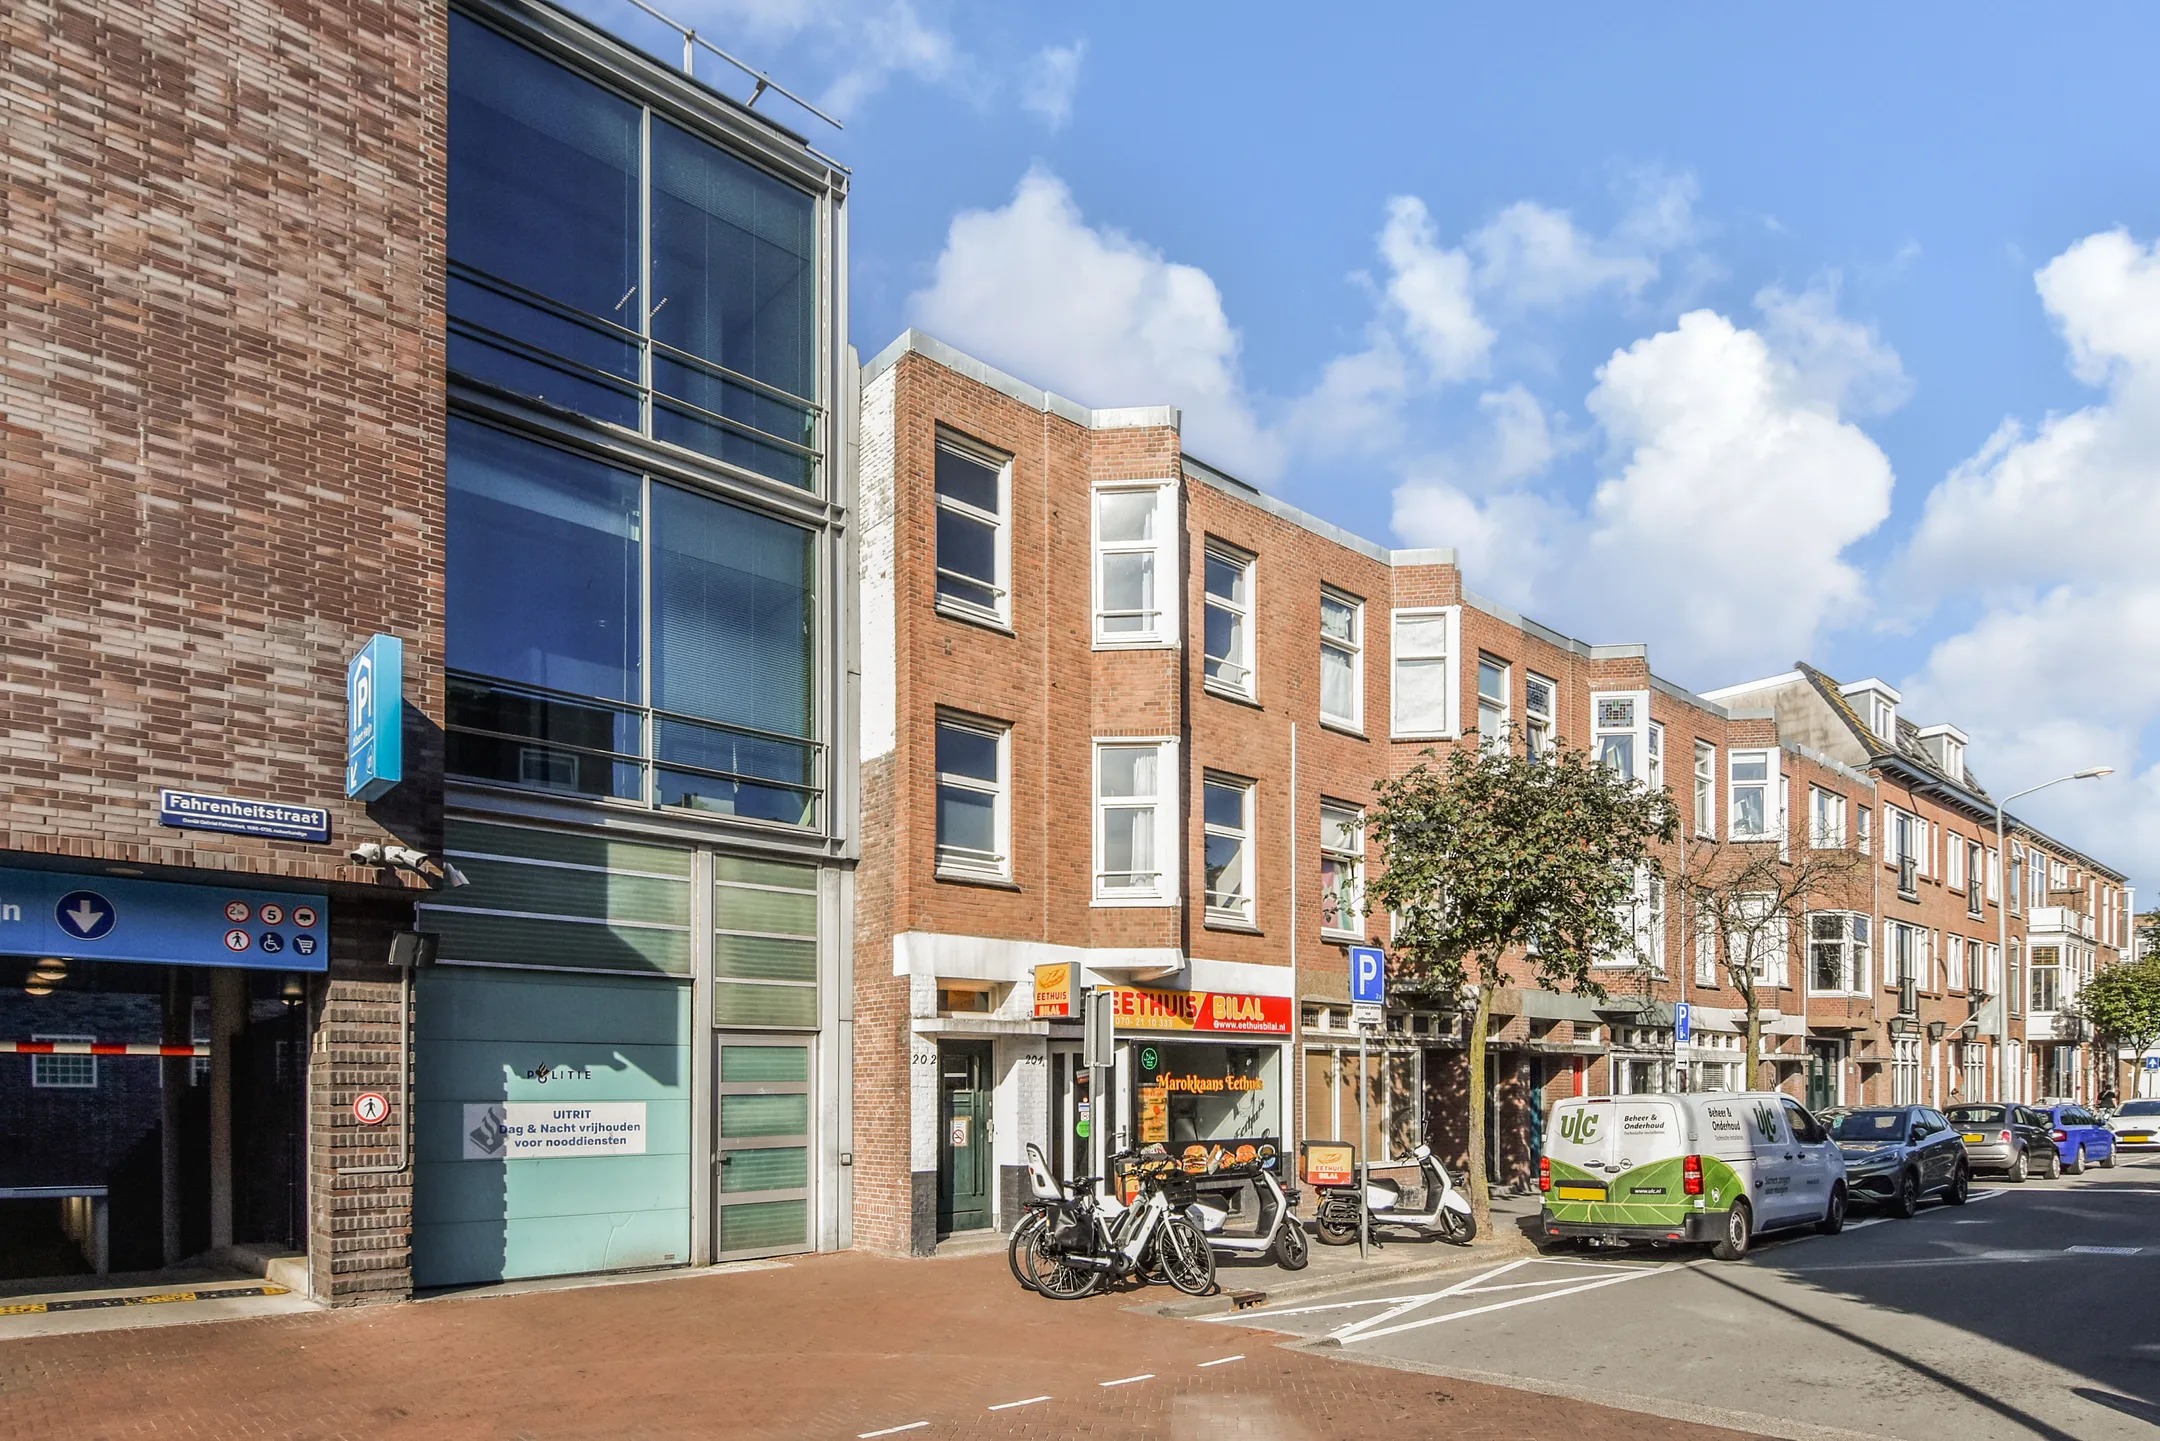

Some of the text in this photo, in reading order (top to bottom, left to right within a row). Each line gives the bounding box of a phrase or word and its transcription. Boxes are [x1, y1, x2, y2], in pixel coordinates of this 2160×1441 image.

[170, 795, 319, 824] Fahrenheitstraat
[267, 910, 276, 920] 5
[1359, 954, 1377, 995] P
[1037, 992, 1067, 1001] EETHUIS
[1039, 1004, 1061, 1016] BILAL
[1213, 995, 1264, 1021] BILAL
[1136, 1018, 1145, 1026] 21
[1148, 1018, 1157, 1027] 10
[1218, 1021, 1286, 1031] www.eethuisbilal.nl
[912, 1054, 937, 1065] 202
[527, 1067, 591, 1084] POLITIE
[1155, 1072, 1264, 1094] Marokkaans Eethuis
[553, 1109, 592, 1119] UITRIT
[1624, 1114, 1648, 1122] Beheer
[1707, 1107, 1732, 1118] Beheer &
[499, 1122, 641, 1136] Dag & Nacht vrijhouden
[1623, 1121, 1665, 1130] Onderhoud
[1711, 1120, 1741, 1131] Onderhoud
[514, 1136, 627, 1147] voor nooddiensten
